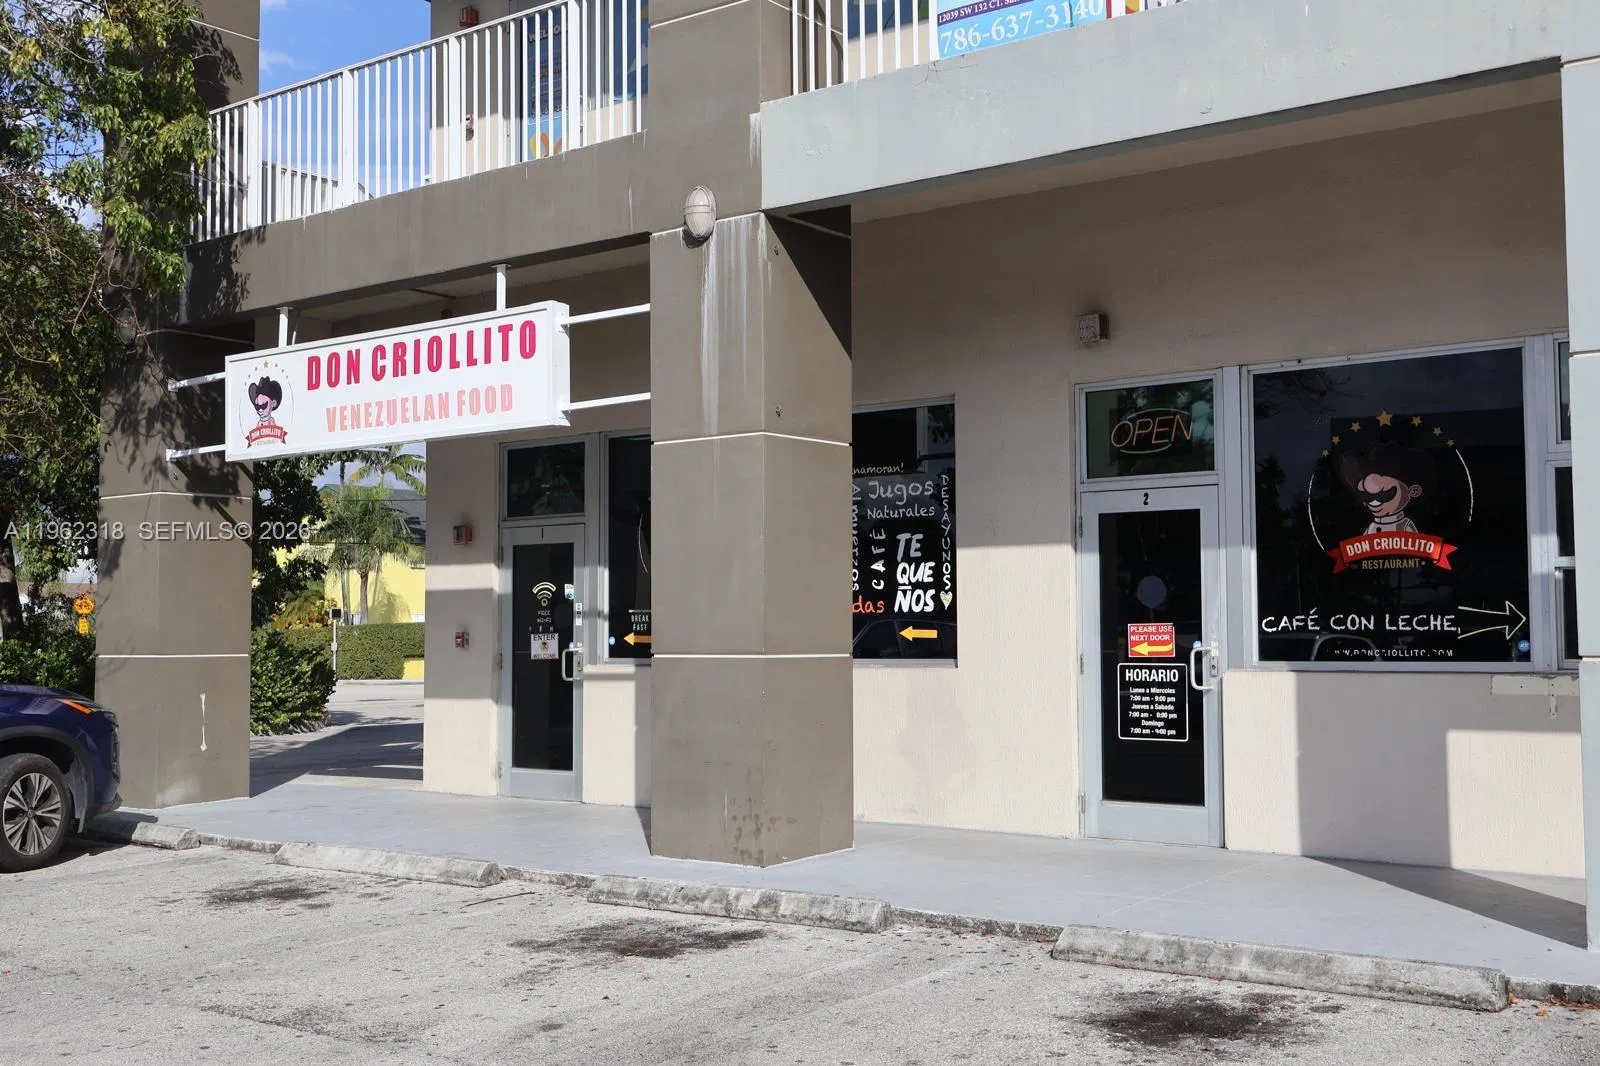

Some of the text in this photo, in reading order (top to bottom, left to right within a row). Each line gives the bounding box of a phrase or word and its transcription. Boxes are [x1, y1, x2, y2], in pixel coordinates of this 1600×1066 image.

[939, 10, 959, 23] 12039
[959, 5, 973, 17] SW
[974, 2, 988, 14] 132
[940, 0, 1104, 54] 786-637-3140
[307, 319, 537, 391] DON CRIOLLITO
[326, 383, 513, 433] VENEZUELAN FOOD
[1111, 415, 1193, 447] OPEN
[852, 462, 904, 475] namoran!
[867, 480, 934, 506] Jugos
[1143, 492, 1149, 506] 2
[867, 504, 935, 520] Naturales
[941, 474, 952, 591] DESAYUNOS
[896, 533, 924, 562] TE
[1346, 537, 1435, 557] DON CRIOLLITO
[870, 529, 886, 590] CAFÉ
[1362, 558, 1421, 570] RESTAURANT
[896, 562, 935, 586] QUE
[893, 585, 935, 613] ÑOS
[632, 623, 648, 631] FAST
[1130, 625, 1157, 633] PLEASE
[1261, 608, 1321, 633] CAFÉ
[1330, 614, 1375, 631] CON
[533, 633, 556, 641] ENTER
[1125, 668, 1179, 682] HORARIO
